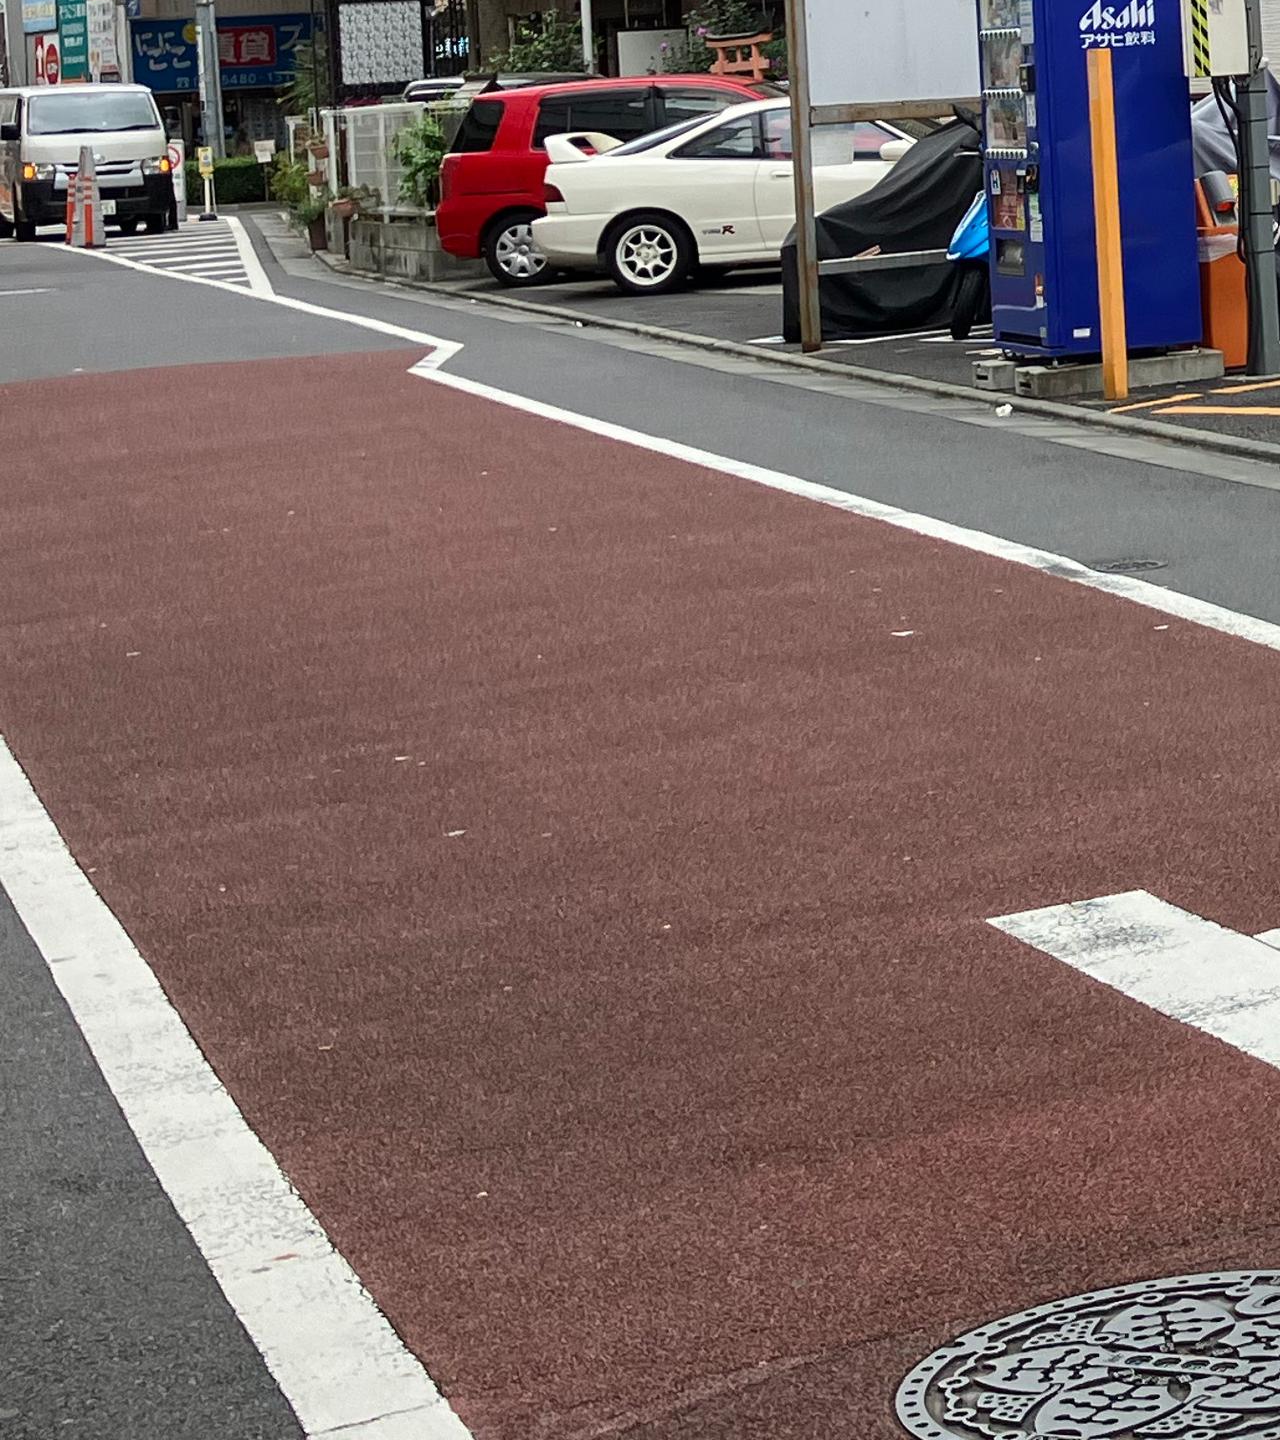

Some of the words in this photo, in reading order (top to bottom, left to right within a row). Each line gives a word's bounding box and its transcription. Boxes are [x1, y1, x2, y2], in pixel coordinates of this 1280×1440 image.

[1080, 30, 1155, 48] アサヒ飲料
